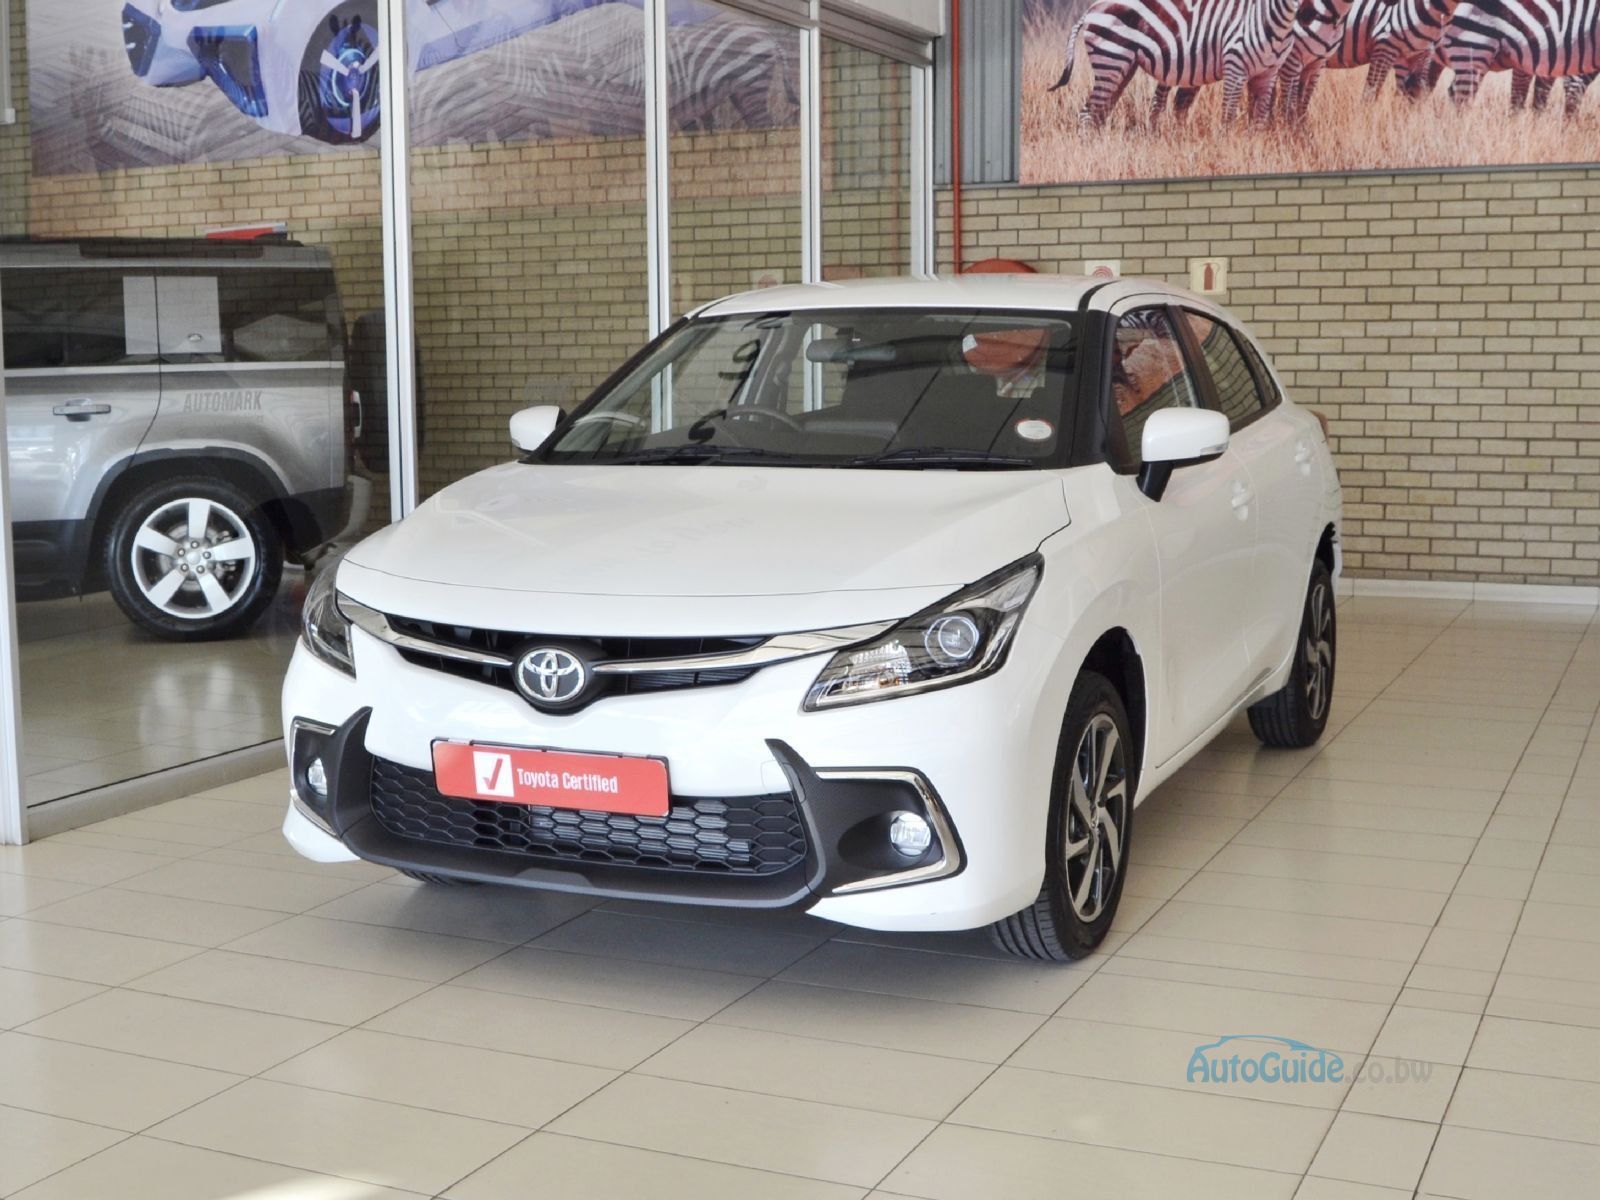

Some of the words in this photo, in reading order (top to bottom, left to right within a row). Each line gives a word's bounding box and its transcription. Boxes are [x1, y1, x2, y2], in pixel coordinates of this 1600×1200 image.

[183, 390, 262, 413] AUTOMARK
[516, 767, 559, 789] Toyota
[562, 771, 619, 794] Certified
